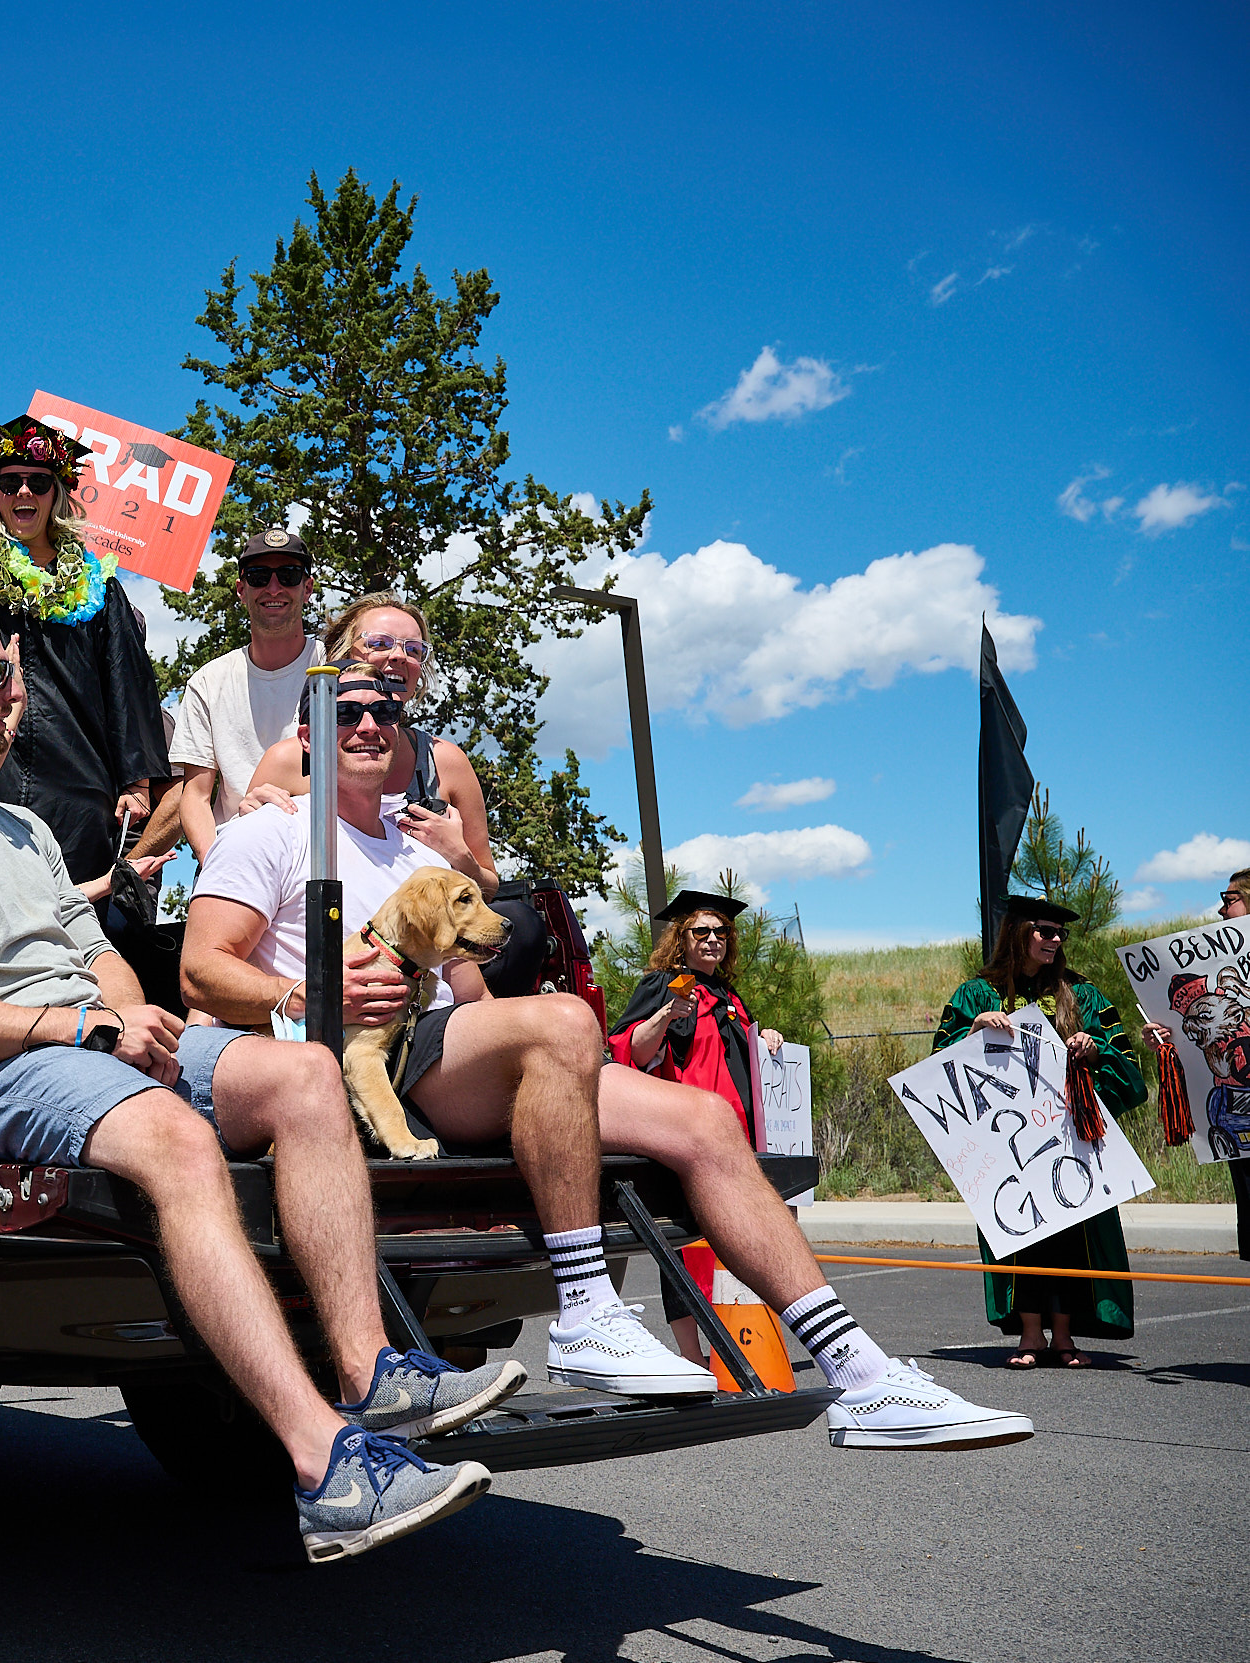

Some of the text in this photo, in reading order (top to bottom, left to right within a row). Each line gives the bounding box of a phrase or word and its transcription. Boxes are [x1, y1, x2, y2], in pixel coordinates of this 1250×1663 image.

[80, 485, 175, 534] 021
[115, 530, 147, 548] University
[1125, 926, 1245, 982] GO BEND
[902, 1023, 1043, 1135] WAY
[947, 1136, 980, 1178] Bend
[991, 1108, 1062, 1171] 2
[962, 1152, 997, 1205] Beavs
